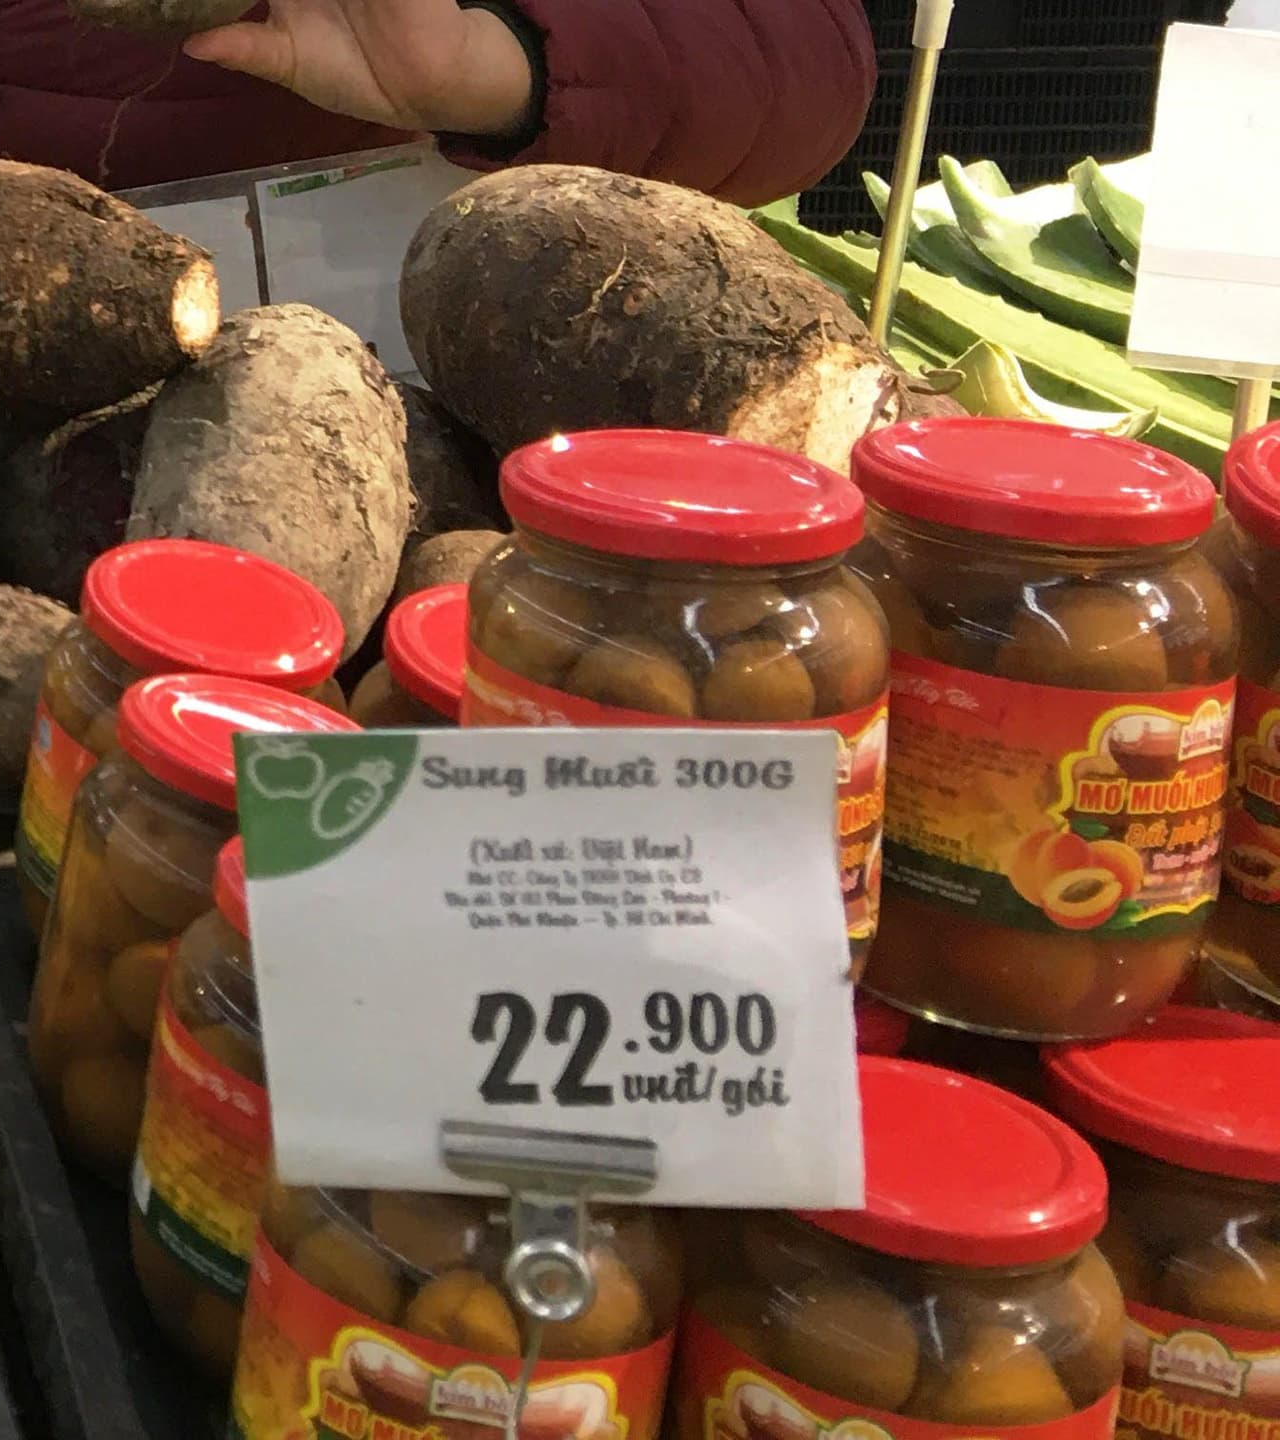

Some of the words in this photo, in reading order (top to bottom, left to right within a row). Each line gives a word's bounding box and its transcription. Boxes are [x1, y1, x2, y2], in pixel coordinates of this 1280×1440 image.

[420, 756, 529, 799] Sung
[544, 755, 660, 791] Muối
[674, 756, 797, 792] 300G
[1075, 777, 1128, 815] MƠ
[1128, 768, 1193, 815] MUỐI
[470, 990, 778, 1109] 22.900
[622, 1061, 792, 1118] vnđ/gói
